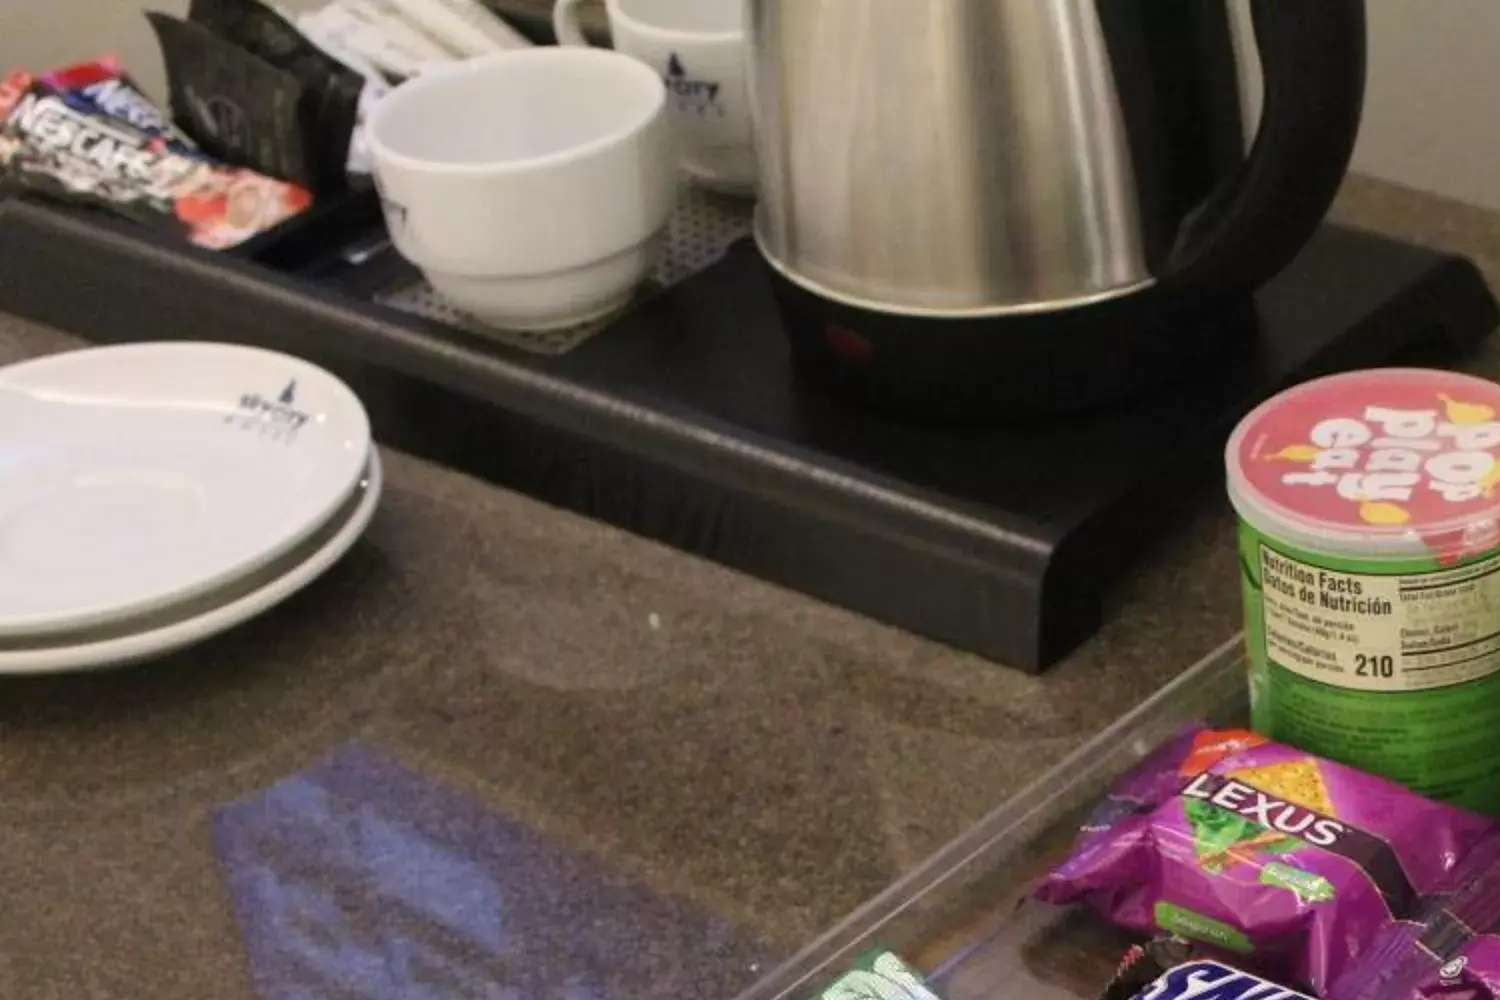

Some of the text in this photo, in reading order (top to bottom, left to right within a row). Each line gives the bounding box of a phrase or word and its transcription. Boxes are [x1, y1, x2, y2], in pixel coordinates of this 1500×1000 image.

[1318, 571, 1364, 595] Facts
[1299, 584, 1316, 605] de
[1319, 590, 1393, 616] Nutrición
[1354, 653, 1394, 678] 210
[1181, 773, 1344, 846] LEXUS
